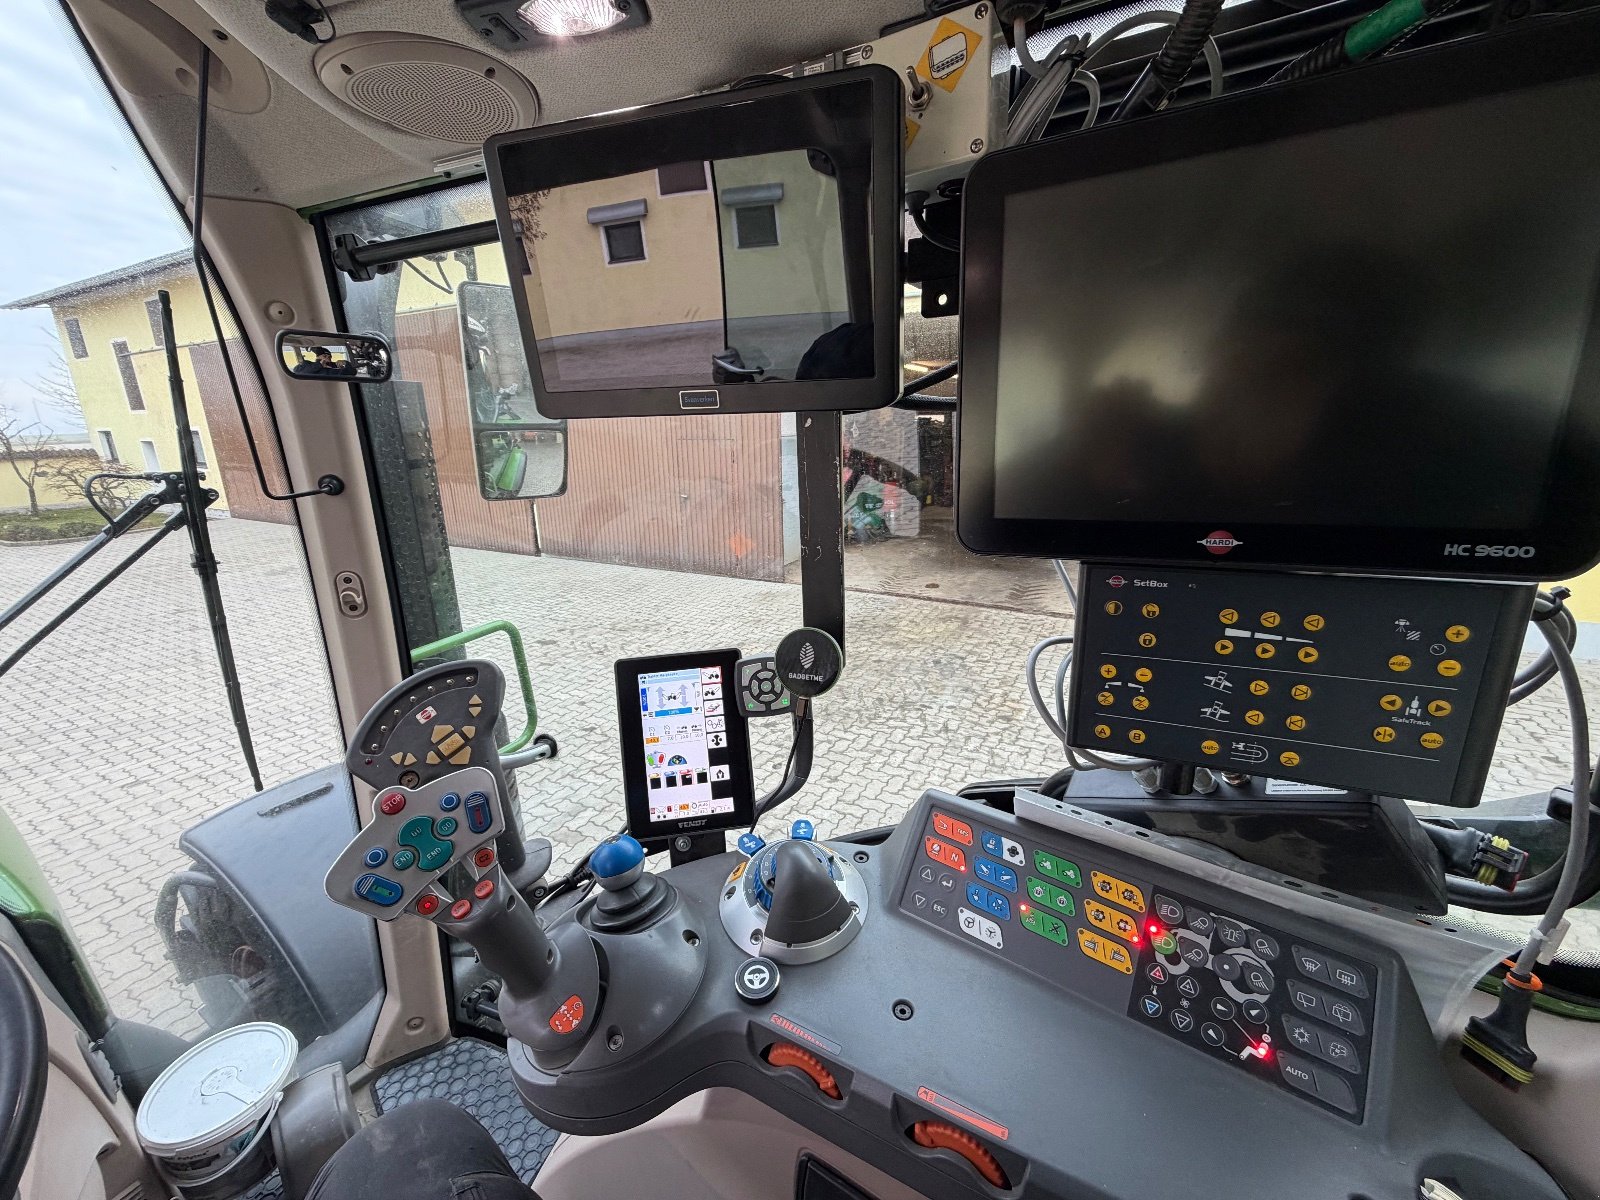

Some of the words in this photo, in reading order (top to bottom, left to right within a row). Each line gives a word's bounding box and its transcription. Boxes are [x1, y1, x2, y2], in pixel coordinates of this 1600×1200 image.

[1443, 543, 1472, 556] HC
[1474, 544, 1536, 559] 9600
[1133, 579, 1169, 588] SetBox
[1389, 660, 1410, 668] auto
[1391, 716, 1432, 727] SafeTrack
[1098, 727, 1107, 736] A
[1132, 732, 1142, 741] B
[1421, 737, 1443, 745] auto
[1202, 744, 1218, 752] auto
[382, 794, 404, 812] STOP
[440, 821, 453, 832] GO
[677, 819, 708, 829] FENDT
[410, 826, 423, 837] GO
[425, 846, 443, 861] END
[950, 851, 960, 862] N
[394, 852, 412, 867] END
[933, 903, 946, 915] ESC
[1285, 1065, 1309, 1081] AUTO
